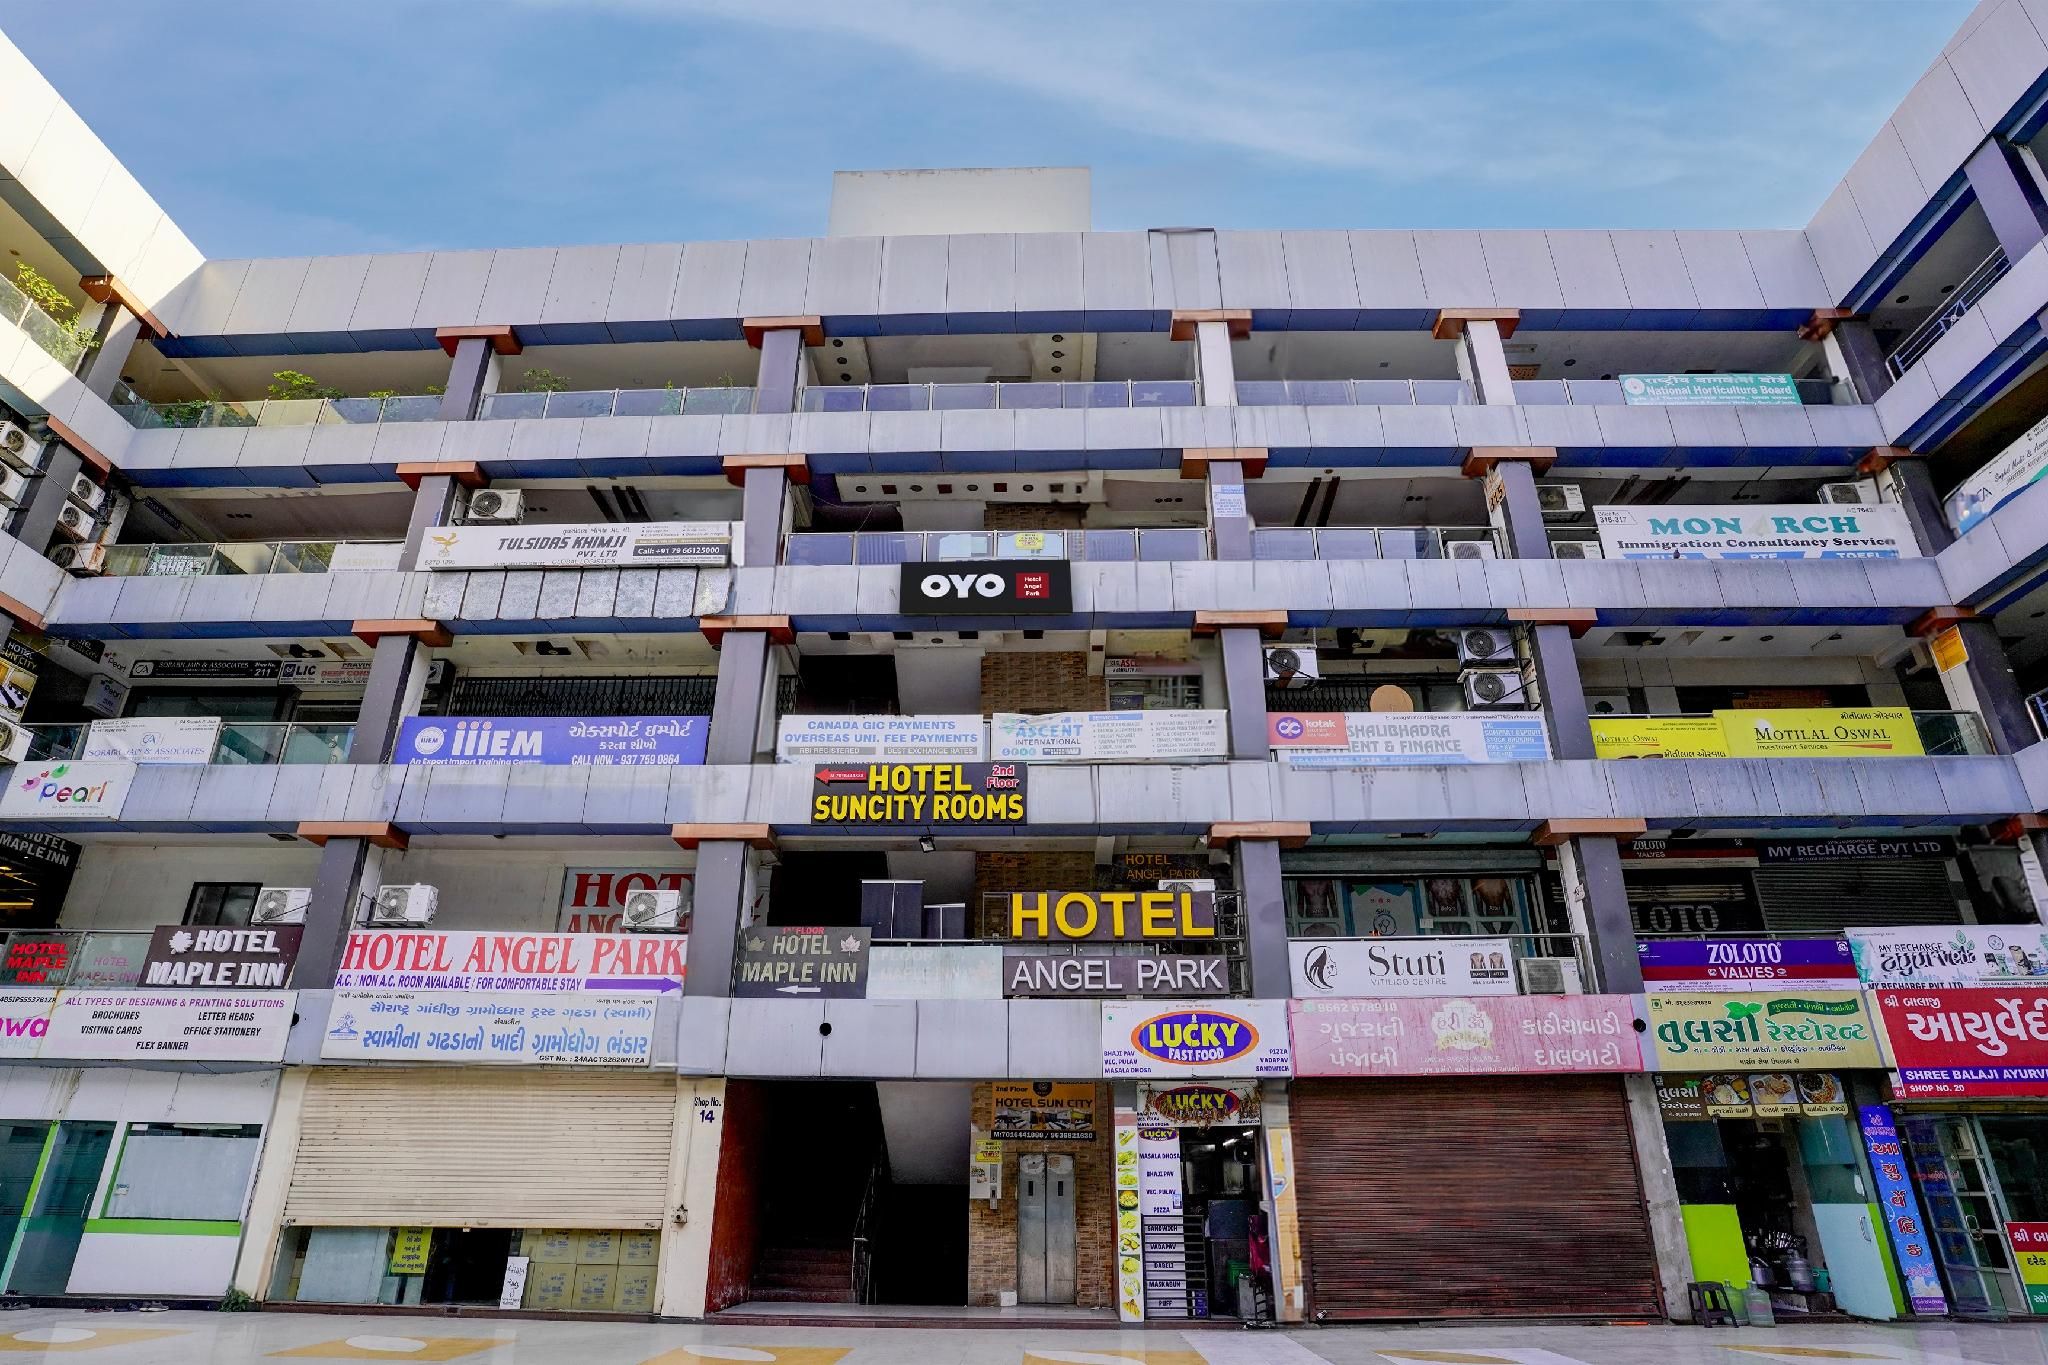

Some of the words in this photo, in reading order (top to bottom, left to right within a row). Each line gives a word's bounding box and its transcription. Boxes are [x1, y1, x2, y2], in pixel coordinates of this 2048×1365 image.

[1646, 386, 1691, 396] National
[1694, 385, 1757, 395] Horticulture
[1761, 385, 1791, 395] Board
[576, 536, 627, 549] KHIMJI
[1617, 539, 1718, 550] Immigration
[1726, 537, 1829, 550] Consultancy
[921, 574, 1006, 598] OYO
[254, 668, 272, 677] 211
[296, 665, 316, 675] LIC
[807, 721, 859, 730] CANADA
[862, 721, 885, 730] GIC
[889, 721, 956, 730] PAYMENTS
[1305, 719, 1337, 728] kotak
[1016, 724, 1083, 737] ASCENT
[1755, 728, 1826, 740] MOTILAL
[1834, 727, 1891, 739] OSWAL
[784, 734, 850, 742] OVERSEAS
[854, 734, 880, 742] UNI.
[884, 734, 907, 742] FEE
[911, 734, 978, 742] PAYMENTS
[1401, 740, 1462, 753] FINANCE
[422, 758, 448, 766] Export
[571, 755, 592, 765] CALL
[594, 755, 614, 765] NOW
[622, 755, 637, 765] 937
[639, 755, 656, 765] 759
[657, 754, 680, 765] 0864
[992, 764, 1015, 777] 2nd
[868, 764, 972, 792] HOTEL
[814, 794, 927, 821] SUNCITY
[933, 794, 1024, 821] ROOMS
[1633, 841, 1666, 849] ZOLOTO
[1768, 846, 1792, 857] MY
[1796, 843, 1876, 857] RECHARGE
[1881, 843, 1909, 855] PVT
[1912, 841, 1941, 853] LTD
[1125, 854, 1172, 865] HOTEL
[1126, 869, 1168, 880] ANGEL
[1169, 869, 1201, 879] PARK
[1012, 893, 1215, 939] HOTEL
[797, 927, 825, 935] FLOOR
[194, 929, 281, 954] HOTEL
[772, 935, 833, 955] HOTEL
[1893, 943, 1943, 952] RECHARGE
[11, 943, 69, 955] HOTEL
[341, 934, 453, 973] HOTEL
[462, 936, 580, 975] ANGEL
[589, 938, 687, 976] PARK
[1706, 942, 1782, 964] ZOLOTO
[6, 957, 68, 969] MAPLE
[1368, 946, 1446, 977] Stuti
[15, 970, 48, 983] INN
[146, 962, 232, 985] MAPLE
[236, 962, 286, 987] INN
[742, 961, 813, 984] MAPLE
[820, 961, 858, 984] INN
[1012, 959, 1122, 991] ANGEL
[1137, 958, 1222, 990] PARK
[1719, 966, 1775, 979] VALVES
[335, 974, 352, 987] A.C.
[359, 975, 378, 988] NON
[378, 975, 396, 988] A.C.
[399, 975, 424, 988] ROOM
[424, 975, 471, 989] AVAILABLE
[476, 977, 493, 990] FOR
[495, 977, 558, 990] COMFORTABLE
[559, 978, 582, 991] STAY
[66, 997, 82, 1007] ALL
[84, 997, 113, 1008] TYPES
[115, 998, 125, 1008] OF
[128, 998, 177, 1008] DESIGNING
[189, 998, 233, 1008] PRINTING
[234, 999, 285, 1009] SOLUTIONS
[1884, 995, 1899, 1008] શ્રી
[1903, 997, 1941, 1009] બાલાજી
[92, 1010, 141, 1021] BROCHURES
[198, 1011, 226, 1021] LETTER
[228, 1011, 255, 1021] HEADS
[81, 1025, 114, 1035] VISITING
[116, 1025, 143, 1035] CARDS
[183, 1026, 212, 1036] OFFICE
[213, 1026, 262, 1037] STATIONERY
[1149, 1023, 1240, 1048] LUCKY
[1320, 1017, 1404, 1043] ગુજરાતી
[1657, 1008, 1760, 1053] તુલસી
[135, 1040, 156, 1051] FLEX
[157, 1041, 188, 1051] BANNER
[1168, 1048, 1195, 1061] FAST
[1195, 1047, 1224, 1061] FOOD
[1330, 1047, 1398, 1067] પંજાબી
[1905, 1071, 1951, 1080] SHREE
[1952, 1070, 1999, 1080] BALAJI
[2003, 1069, 2048, 1079] AYURV
[694, 1097, 709, 1108] Shop
[710, 1097, 722, 1107] No.
[996, 1098, 1037, 1108] HOTEL
[1038, 1098, 1064, 1108] SUN
[1067, 1098, 1093, 1108] CITY
[699, 1110, 715, 1123] 14
[1143, 1130, 1174, 1139] LUCKY
[1153, 1206, 1170, 1214] PIZZA
[2014, 1228, 2030, 1242] શ્રી
